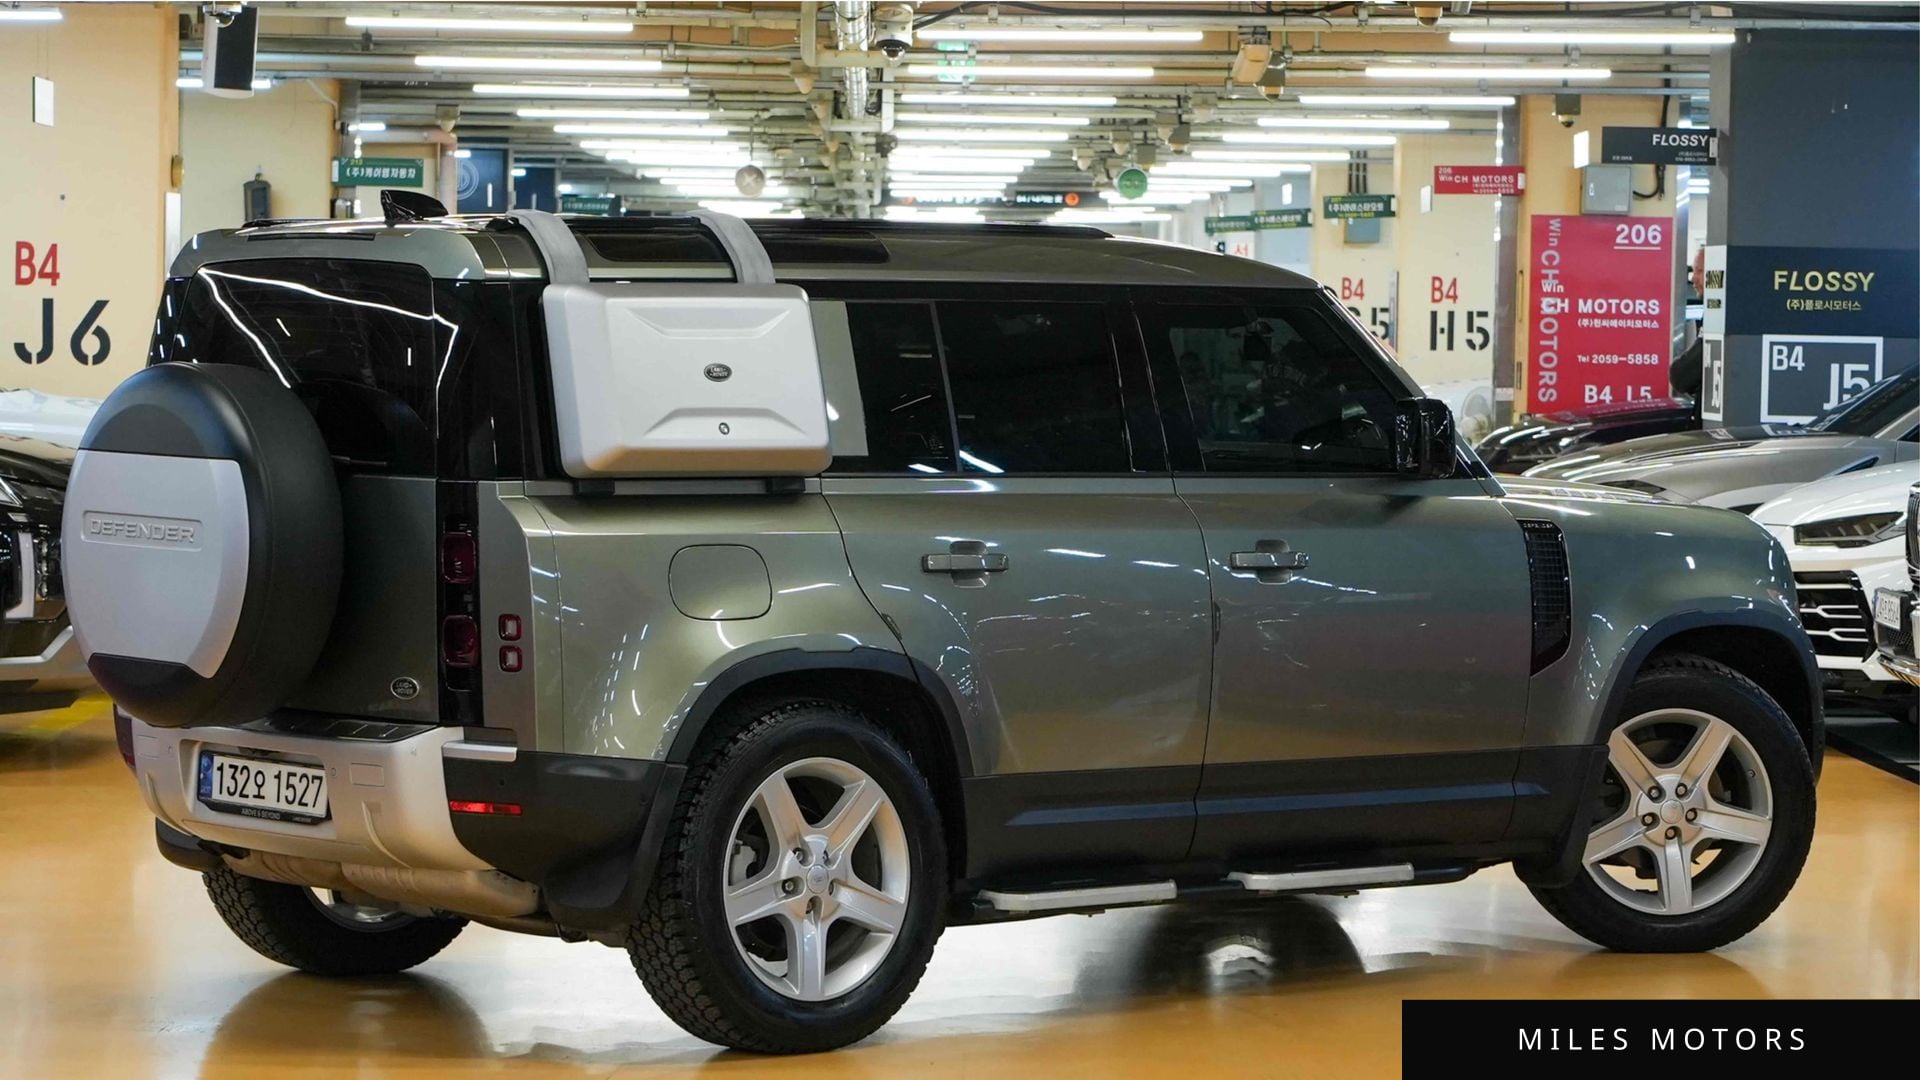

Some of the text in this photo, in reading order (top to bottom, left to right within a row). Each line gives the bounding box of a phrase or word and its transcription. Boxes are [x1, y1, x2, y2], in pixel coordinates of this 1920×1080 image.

[1652, 134, 1708, 147] FLOSSY
[1454, 175, 1469, 183] CH
[1472, 175, 1514, 184] MOTORS
[1549, 218, 1561, 247] Win
[1615, 223, 1662, 244] 206
[15, 240, 61, 287] B4
[1341, 276, 1365, 301] B4
[1430, 276, 1459, 304] B4
[1541, 279, 1565, 293] Win
[1773, 270, 1875, 292] FLOSSY
[1542, 298, 1660, 315] CH MOTORS
[1786, 298, 1862, 311] (주)플로시모터스
[13, 298, 111, 366] J6
[1577, 353, 1659, 365] Tel 2059-5858
[1771, 345, 1806, 372] B4
[1583, 384, 1613, 404] B4
[1822, 363, 1871, 411] J5
[89, 518, 195, 544] DEFENDER
[216, 761, 324, 809] 132오 1527
